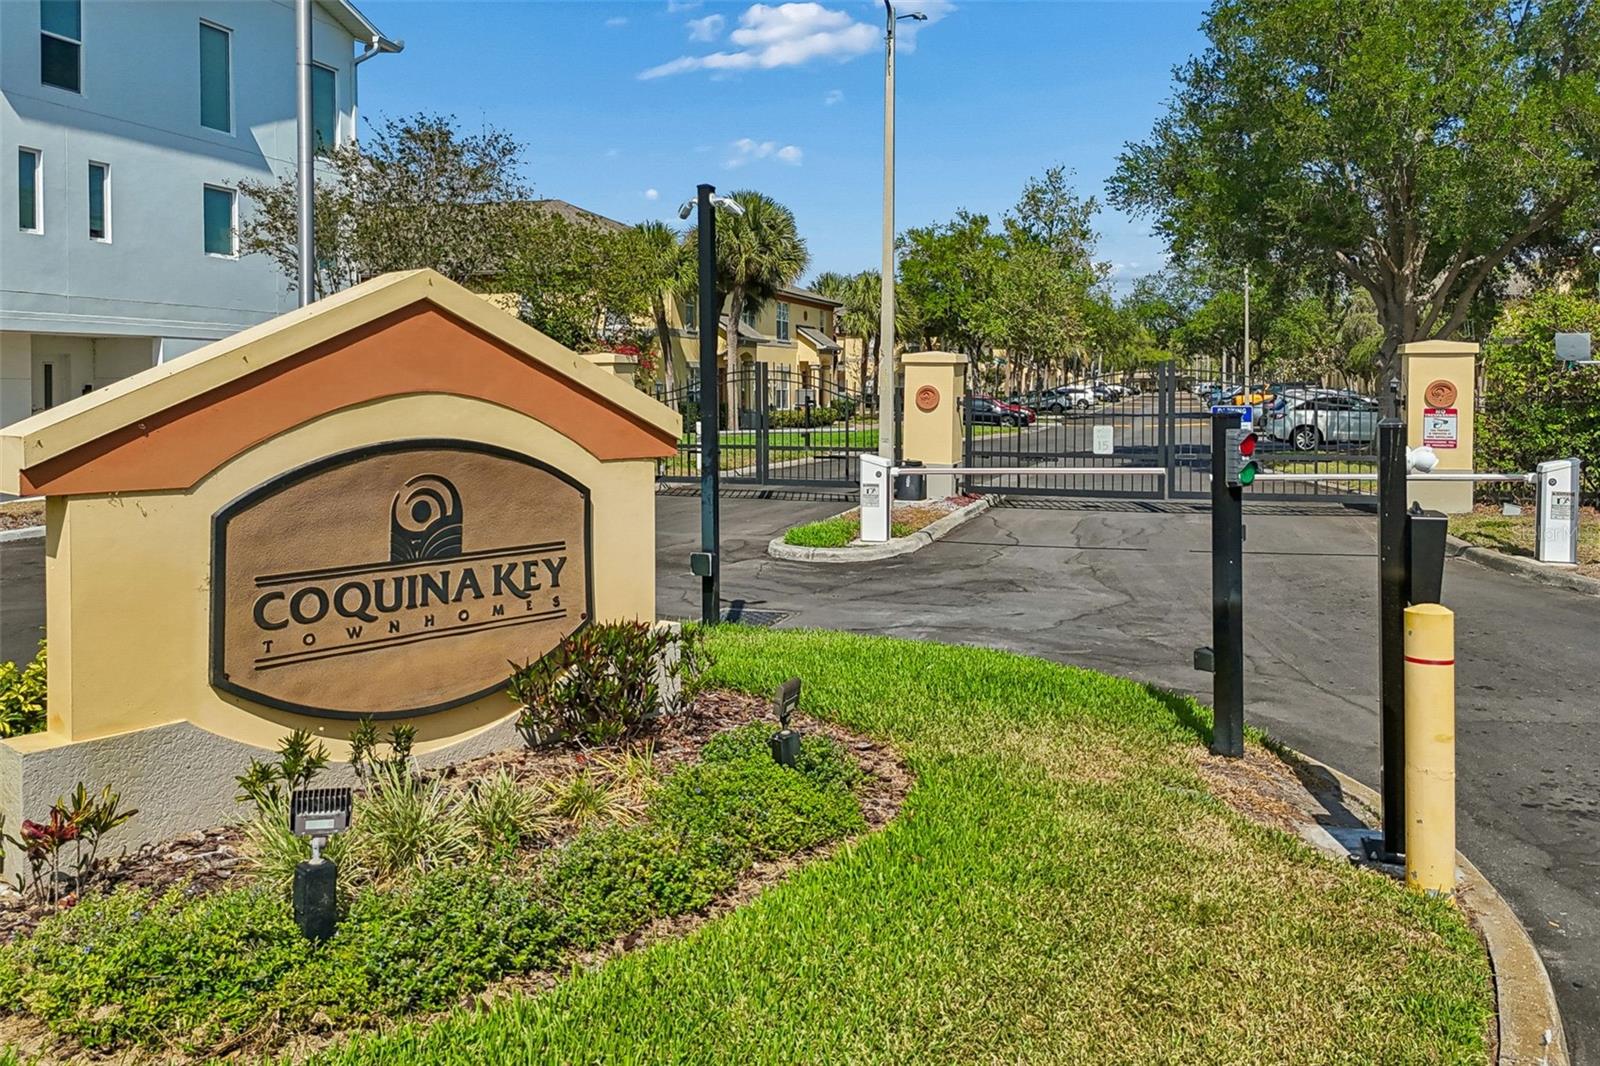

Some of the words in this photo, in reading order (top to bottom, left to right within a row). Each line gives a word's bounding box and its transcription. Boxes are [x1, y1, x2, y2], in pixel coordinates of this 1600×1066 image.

[1098, 440, 1109, 451] 15
[252, 567, 485, 631] COQUINA
[491, 556, 568, 600] KEY
[262, 595, 561, 654] TOWNHOMES
